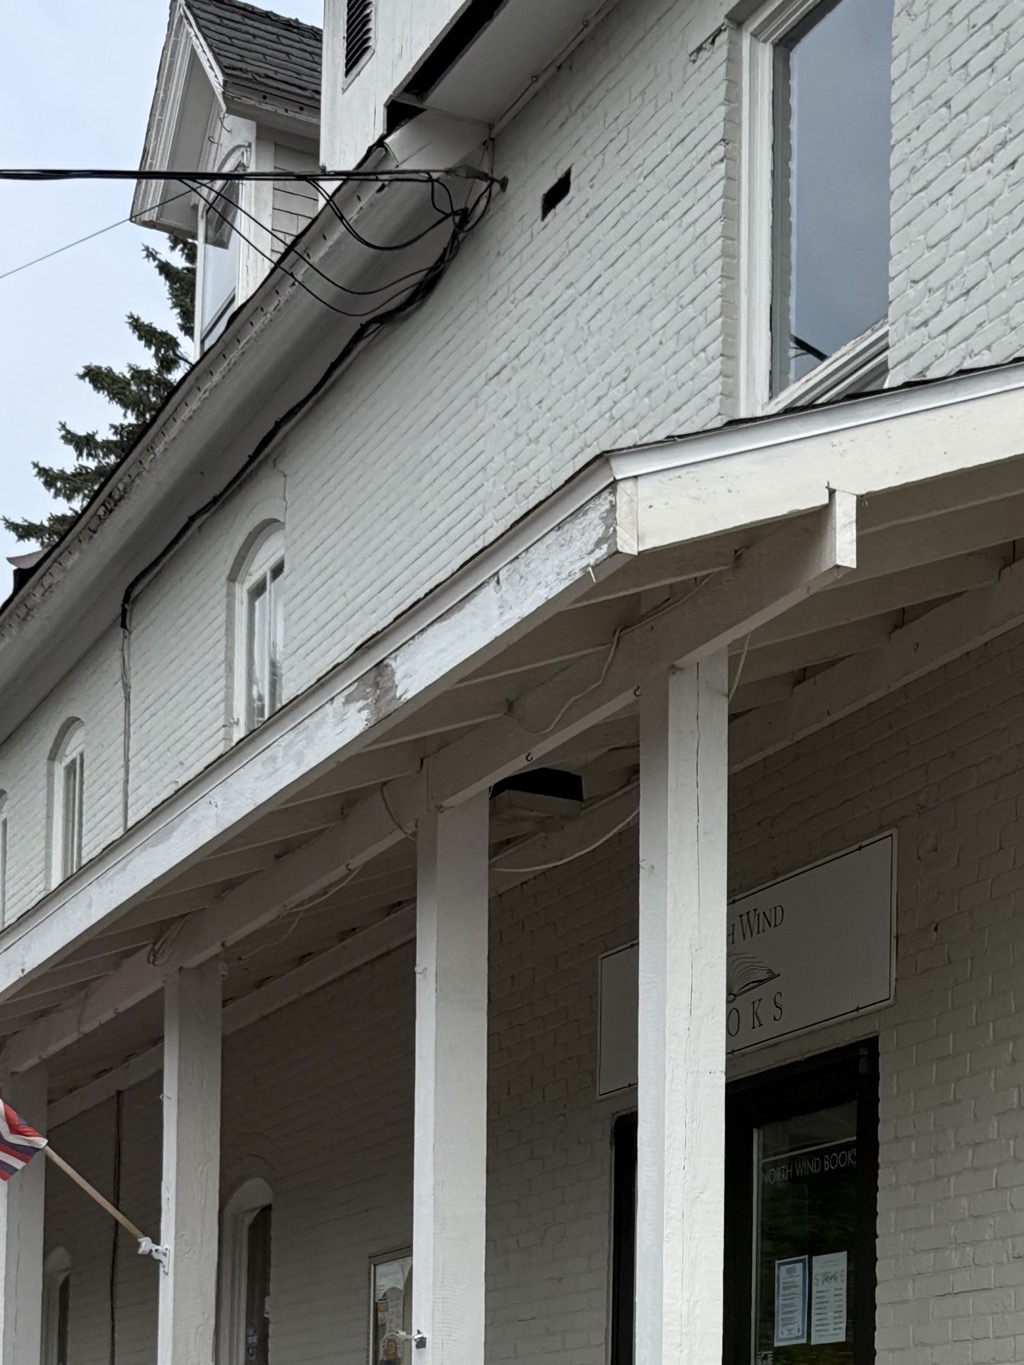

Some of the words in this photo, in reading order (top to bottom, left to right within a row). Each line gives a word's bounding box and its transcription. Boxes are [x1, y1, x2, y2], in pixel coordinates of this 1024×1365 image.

[738, 904, 785, 942] WIND
[727, 991, 784, 1037] OKS
[795, 1156, 822, 1177] WIND
